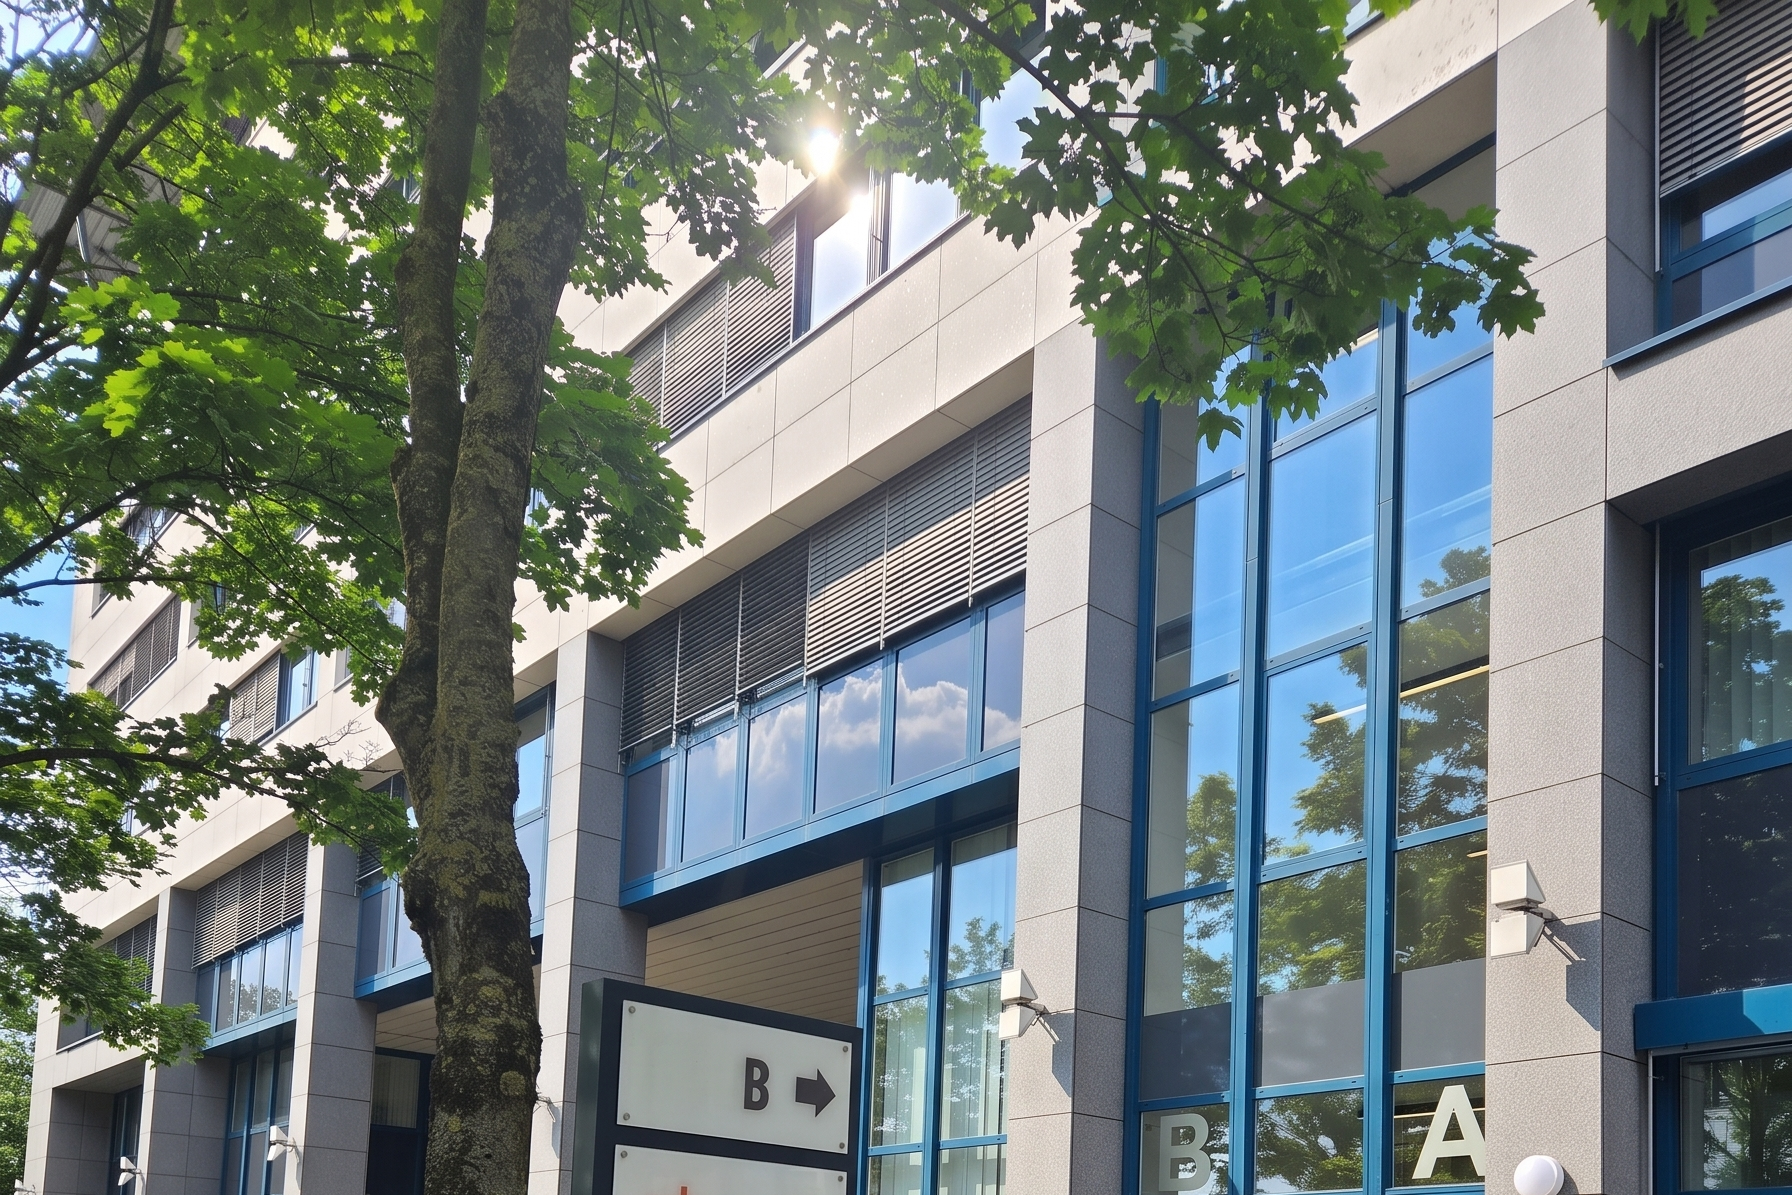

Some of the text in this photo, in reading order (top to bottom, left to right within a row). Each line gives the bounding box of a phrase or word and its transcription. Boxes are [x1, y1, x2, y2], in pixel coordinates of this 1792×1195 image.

[743, 1056, 770, 1111] B
[1157, 1112, 1212, 1192] B
[1411, 1083, 1486, 1180] A
